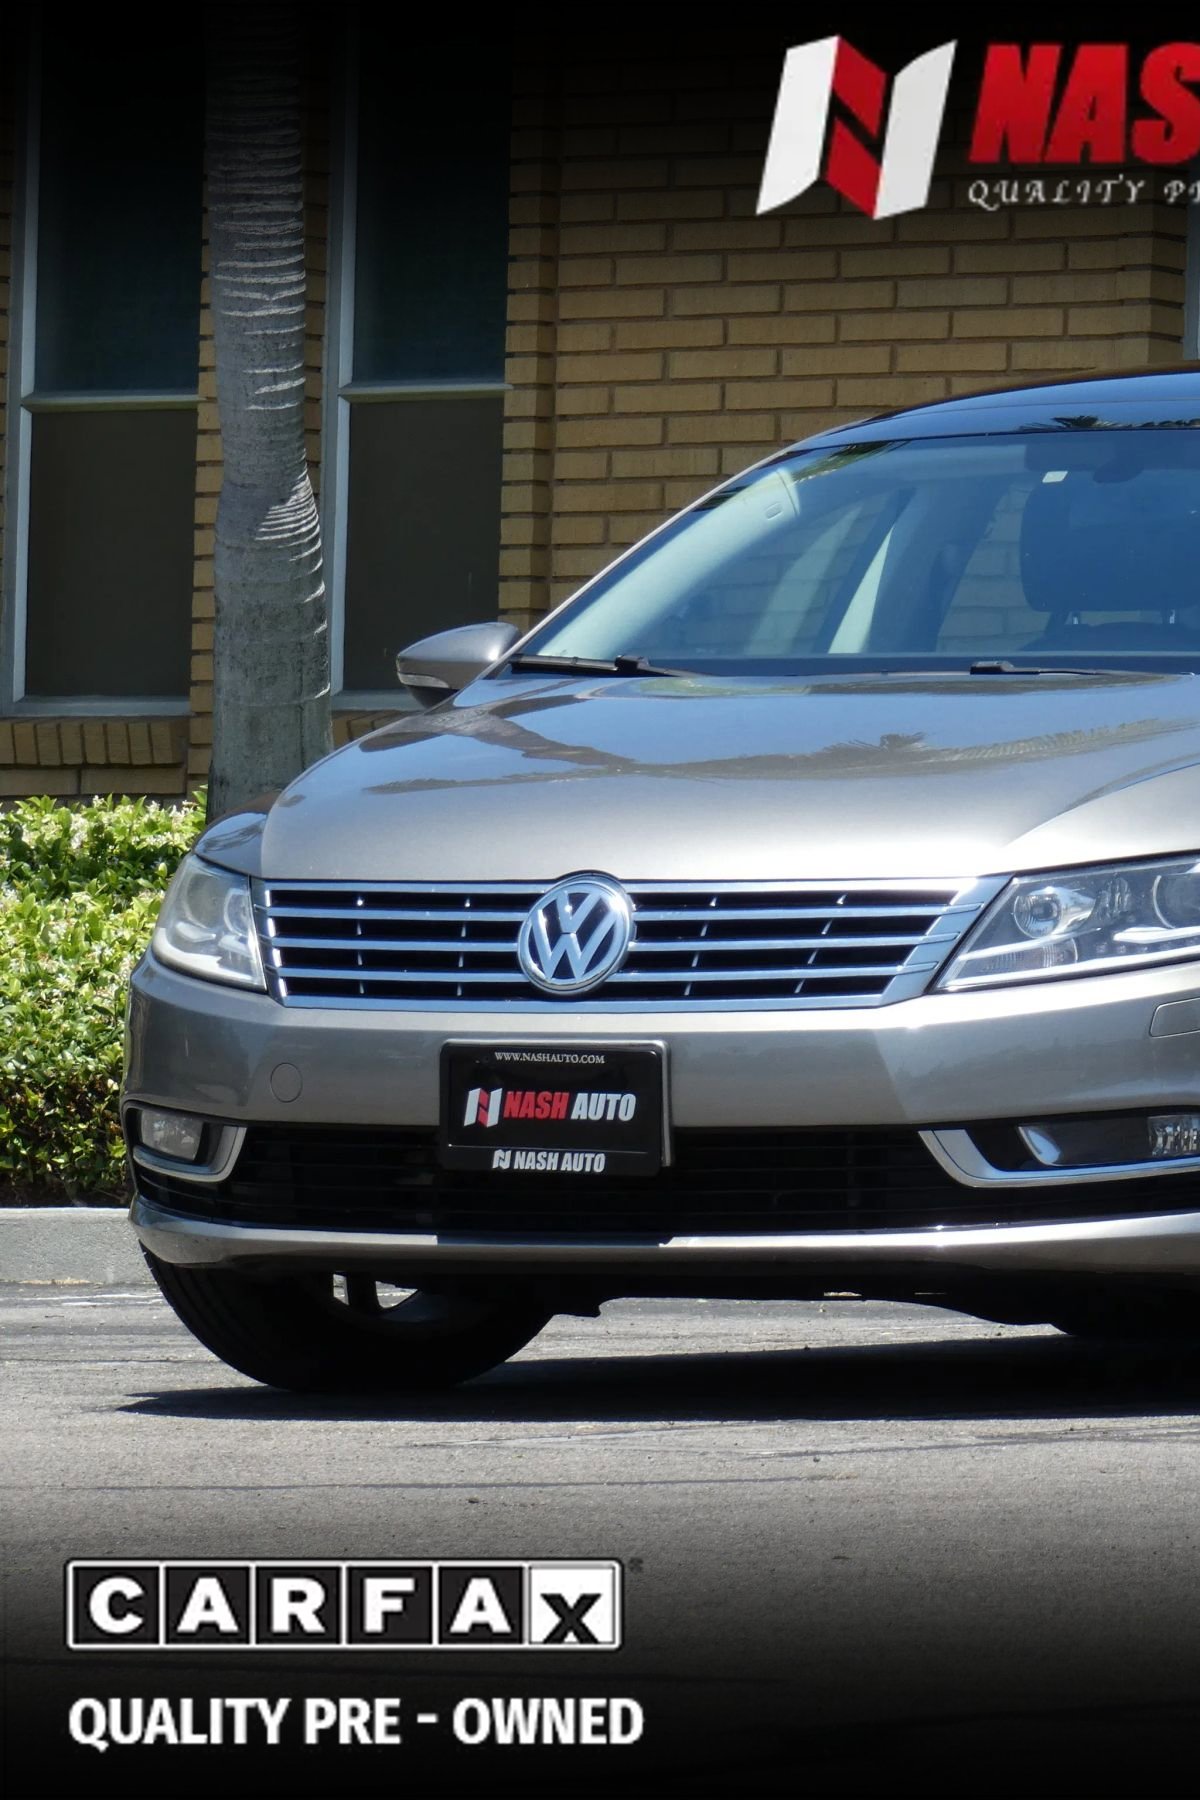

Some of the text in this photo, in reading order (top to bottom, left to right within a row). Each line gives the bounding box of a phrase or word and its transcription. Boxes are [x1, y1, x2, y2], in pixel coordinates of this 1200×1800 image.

[494, 1051, 606, 1065] WWW.NASHAUTO.COM
[503, 1090, 570, 1120] NASH
[570, 1092, 637, 1122] AUTO
[513, 1150, 560, 1171] NASH
[560, 1152, 606, 1173] AUTO
